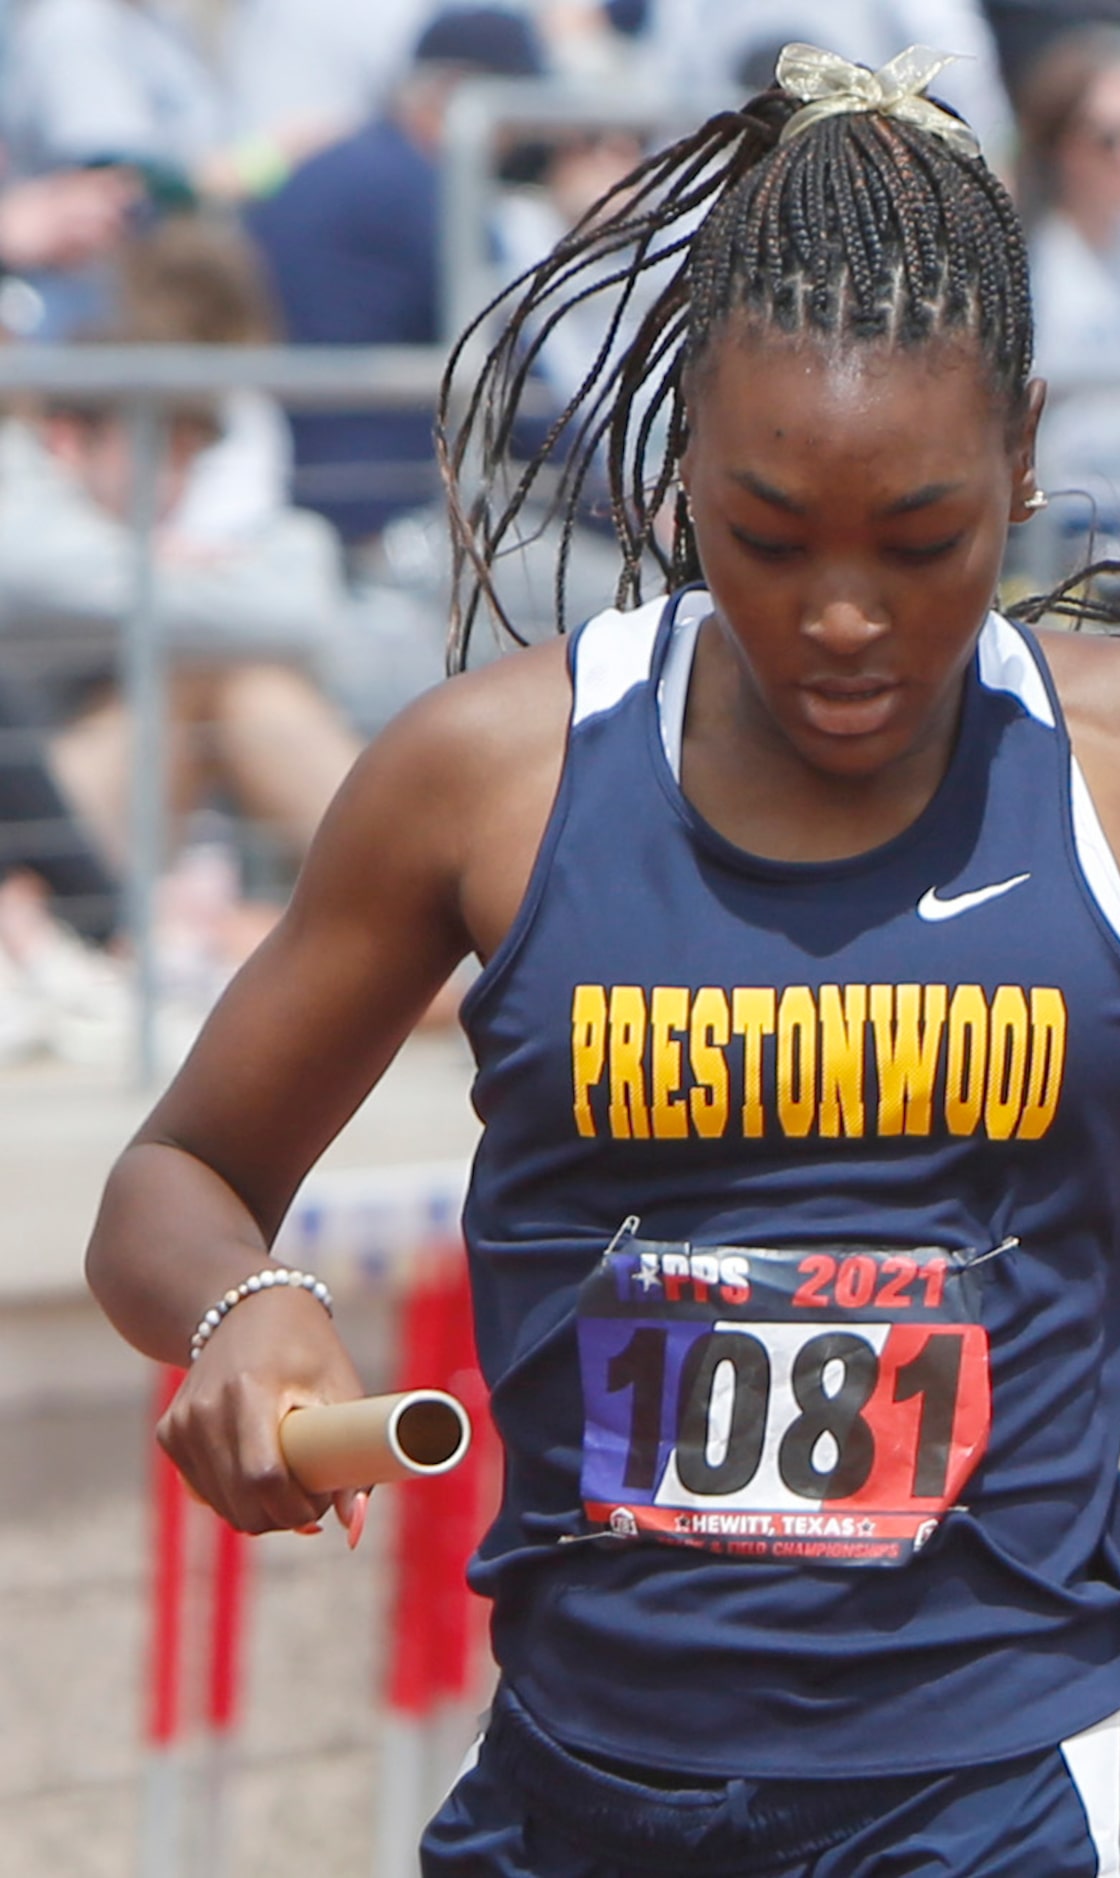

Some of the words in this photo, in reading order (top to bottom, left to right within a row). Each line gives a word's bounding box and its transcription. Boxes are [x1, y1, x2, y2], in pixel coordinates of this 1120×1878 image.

[572, 984, 1067, 1140] PRESTONWOOD
[793, 1254, 949, 1308] 2021
[606, 1327, 964, 1500] 1081
[693, 1514, 775, 1536] HEWITT,
[782, 1516, 855, 1536] TEXAS
[727, 1541, 767, 1556] FIELD
[772, 1541, 899, 1559] CHAMPIONSHIPS
